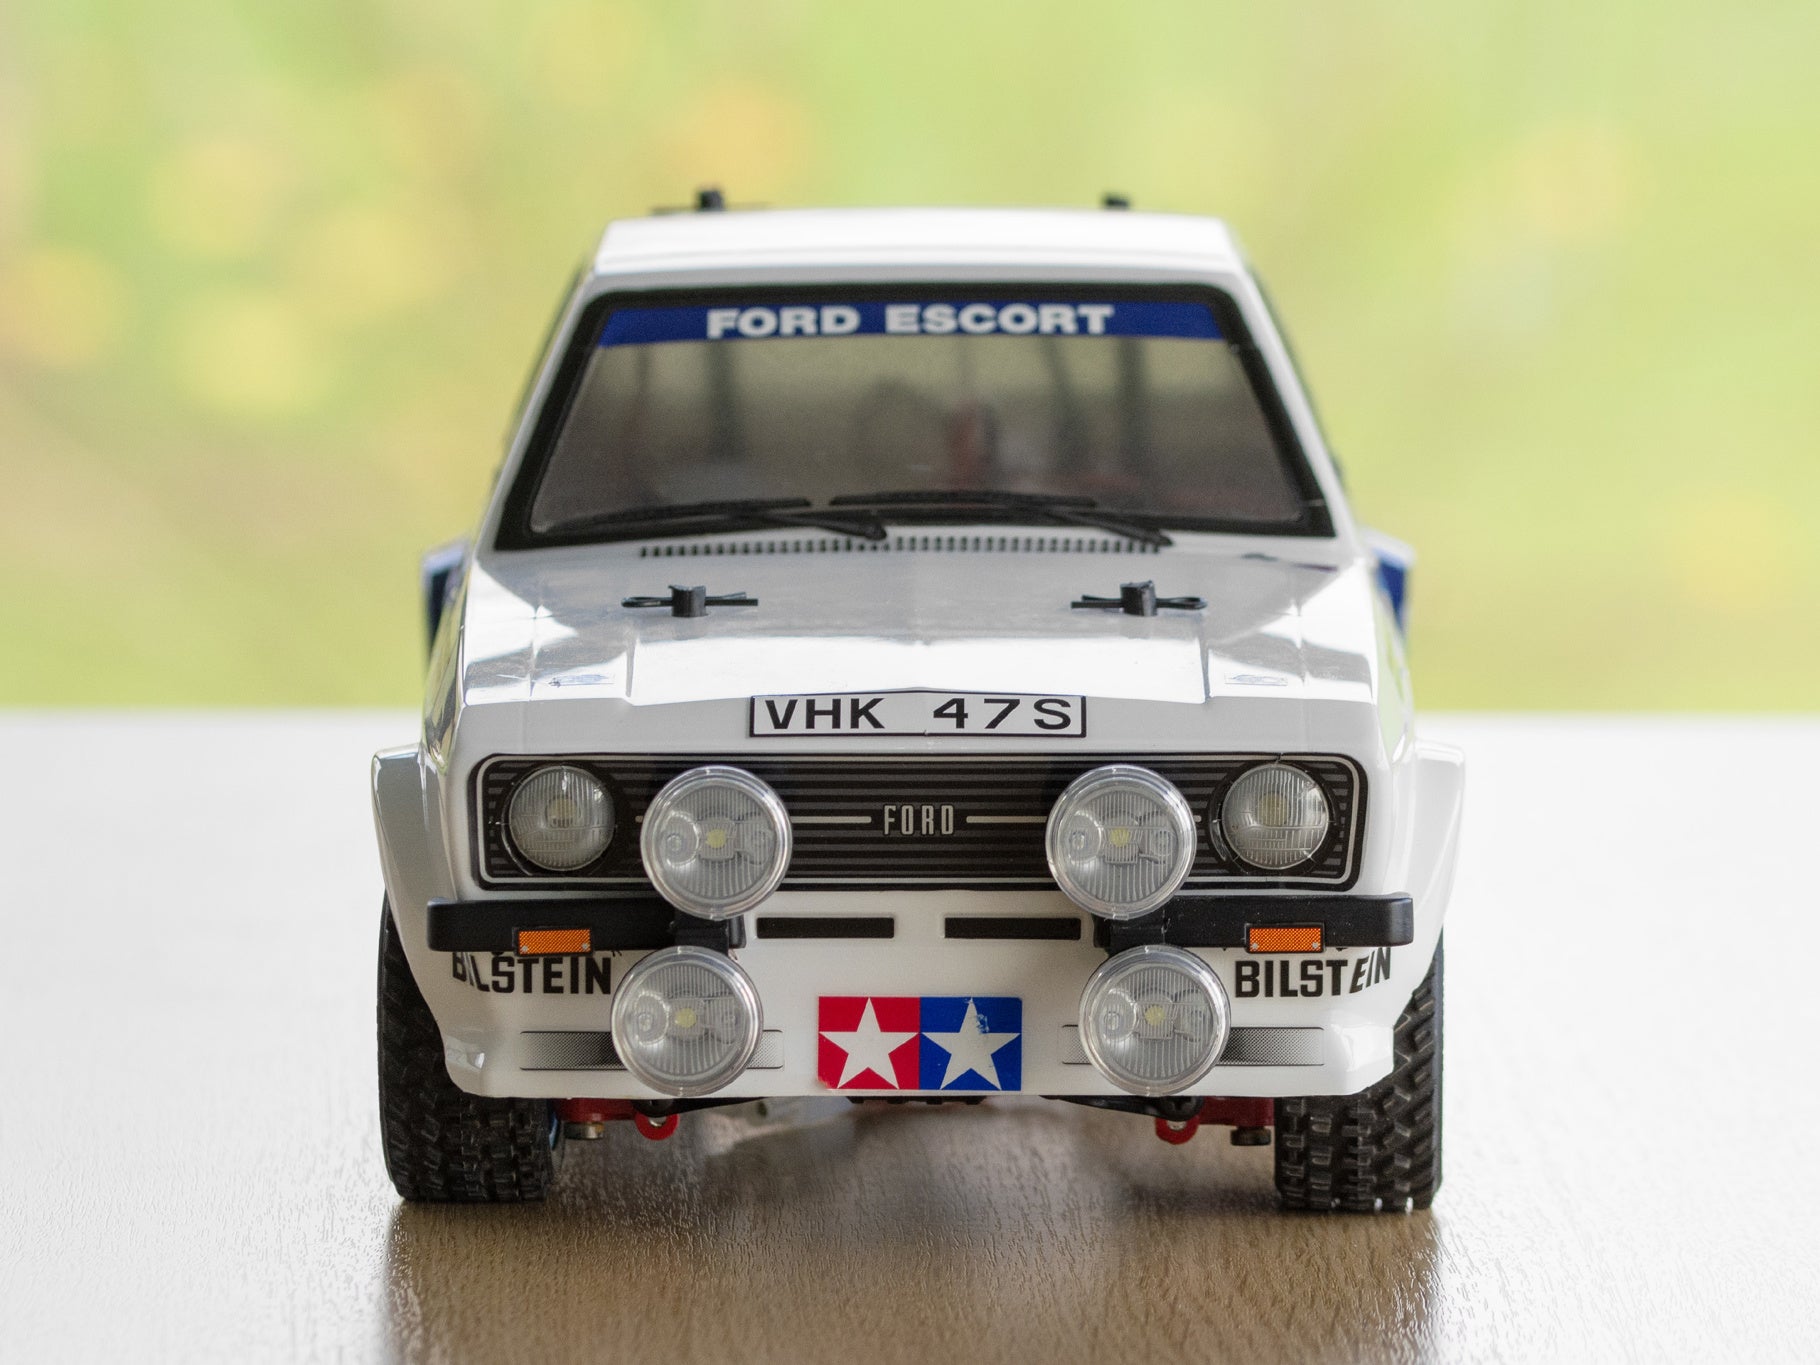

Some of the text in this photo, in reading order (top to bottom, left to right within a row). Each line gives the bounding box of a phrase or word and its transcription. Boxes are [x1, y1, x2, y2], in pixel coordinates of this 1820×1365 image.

[707, 303, 1116, 340] FORD ESCORT
[764, 697, 1073, 731] VHK 47S
[883, 804, 955, 836] FORD
[452, 952, 612, 995] BILSTEIN
[1235, 947, 1392, 998] BILSTEIN
